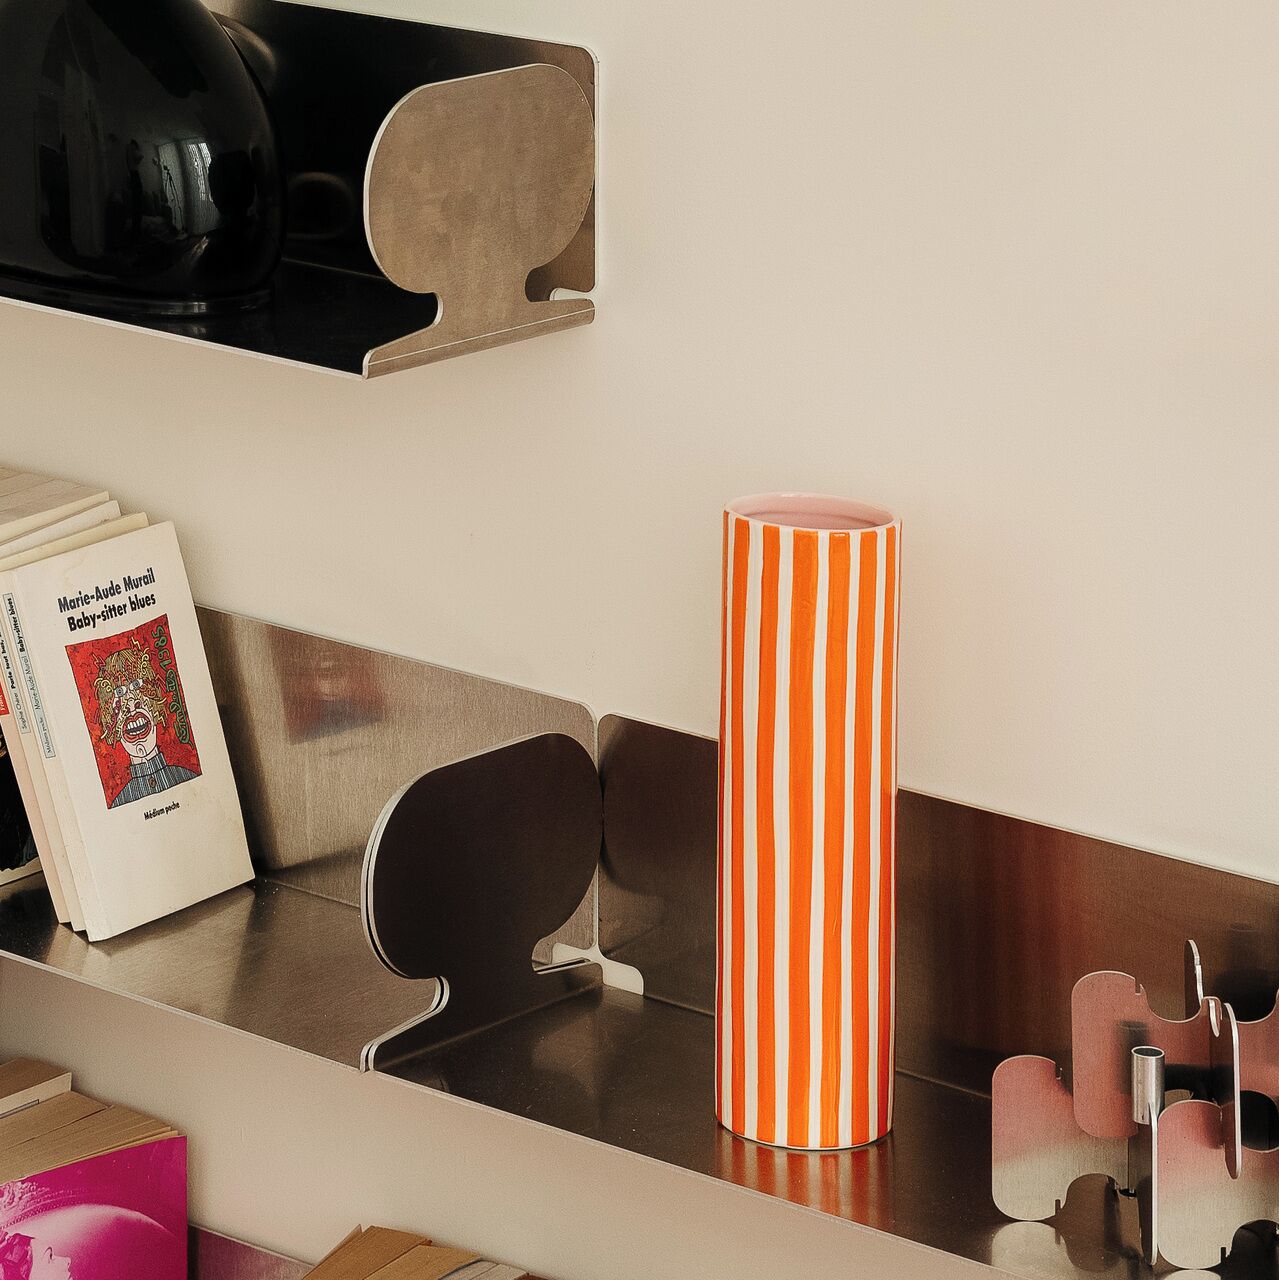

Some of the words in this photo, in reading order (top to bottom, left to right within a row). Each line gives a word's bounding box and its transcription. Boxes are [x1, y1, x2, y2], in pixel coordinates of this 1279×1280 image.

[57, 580, 122, 613] Marie-Aude
[123, 567, 155, 591] Murail
[67, 602, 128, 632] Baby-sitter
[129, 592, 156, 613] blues
[151, 624, 172, 671] 1985
[143, 805, 165, 821] Médium
[164, 801, 180, 815] poche
